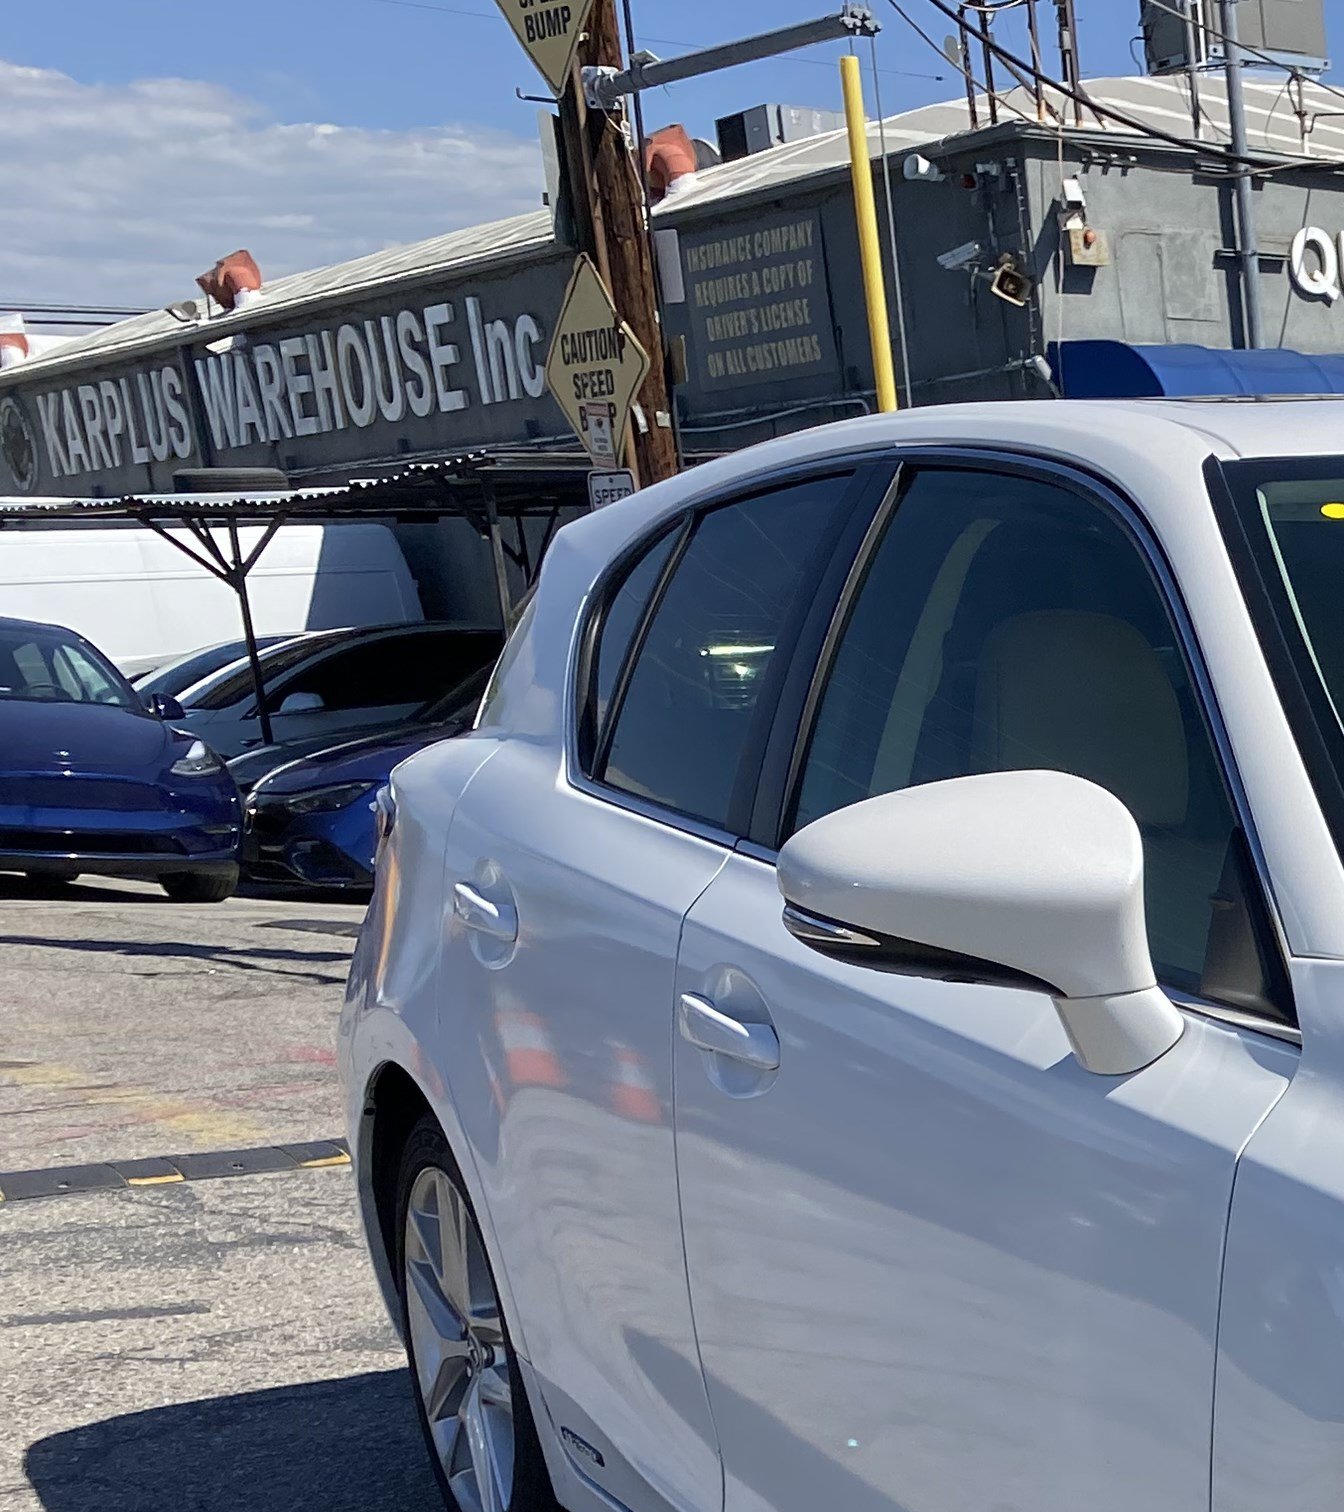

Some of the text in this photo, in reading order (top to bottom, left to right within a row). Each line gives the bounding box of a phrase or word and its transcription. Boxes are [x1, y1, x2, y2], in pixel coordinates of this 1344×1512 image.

[524, 6, 571, 43] BUMP
[686, 219, 813, 272] INSURANCE COMPANY
[695, 259, 813, 307] REQUIRES A COPY OF
[706, 298, 811, 342] DRIVER'S LICENSE
[561, 328, 621, 365] CAUTION
[708, 334, 821, 378] ON ALL CUSTOMERS
[36, 296, 547, 478] KARPLUS WAREHOUSE Inc
[572, 368, 615, 400] SPEED
[579, 402, 617, 432] BP
